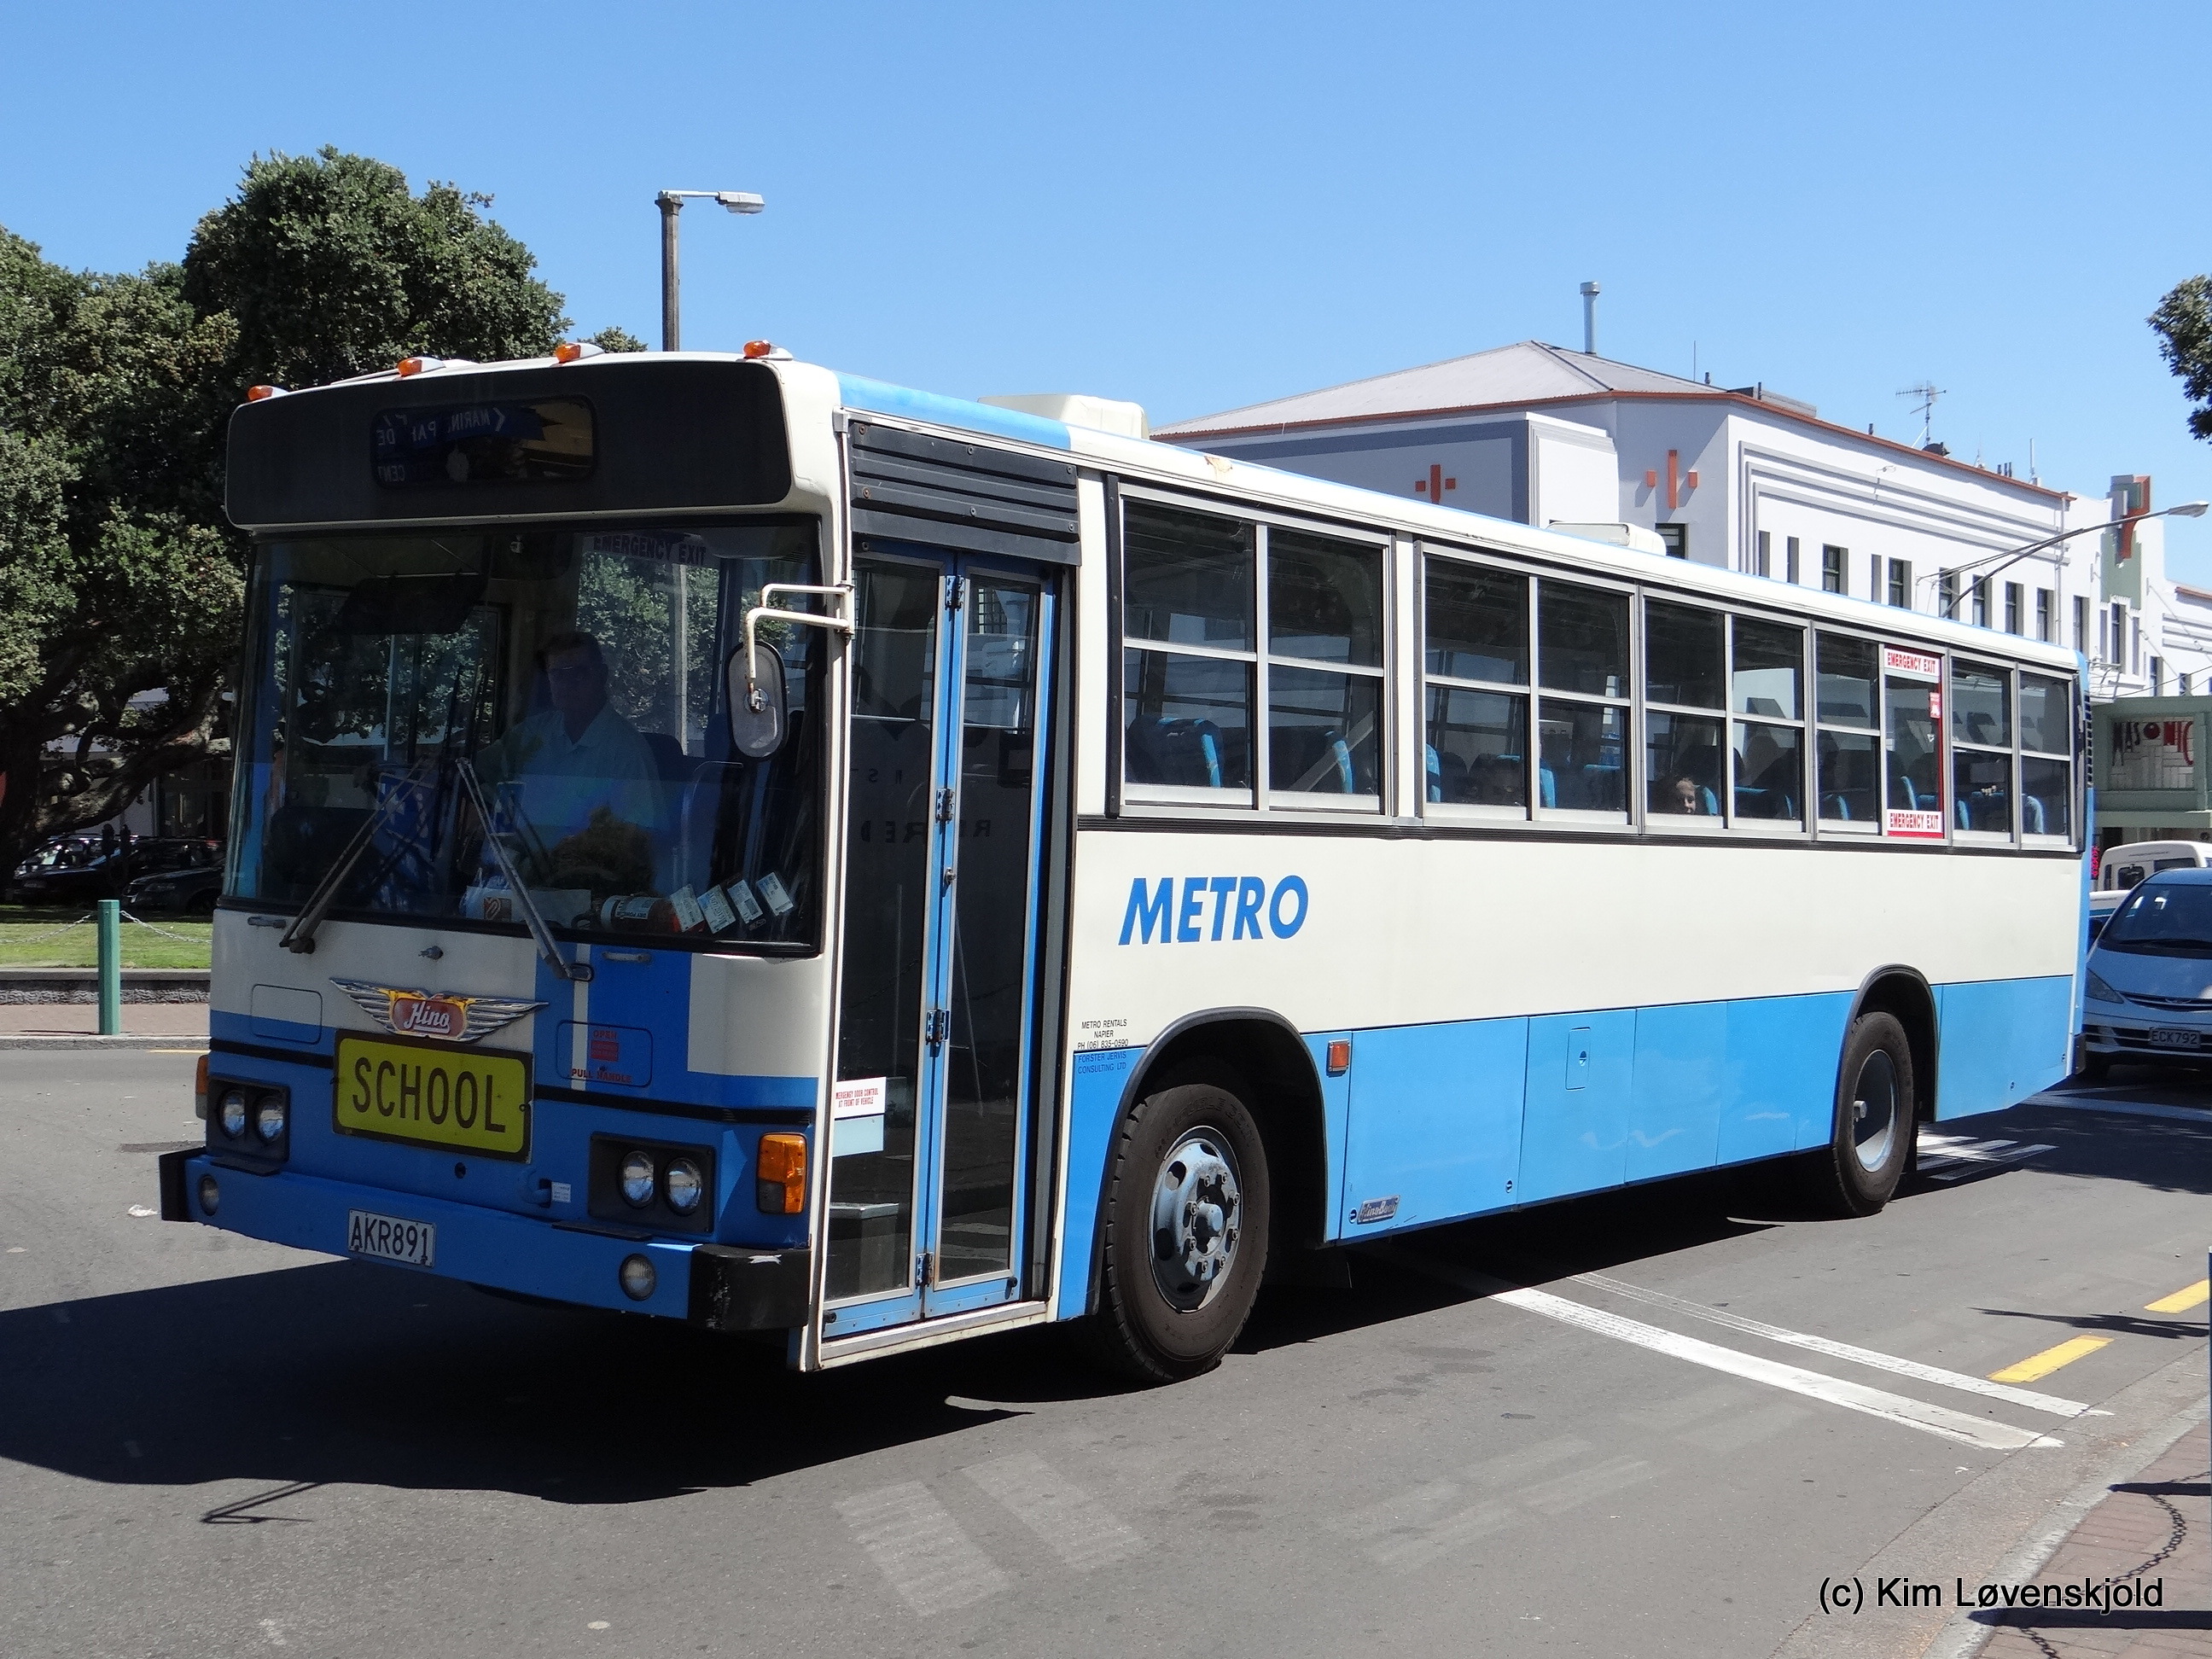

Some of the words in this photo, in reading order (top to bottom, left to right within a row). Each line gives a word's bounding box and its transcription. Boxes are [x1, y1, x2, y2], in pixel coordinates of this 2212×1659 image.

[594, 535, 672, 561] EMERGENCY
[679, 544, 706, 565] EXIT
[1887, 652, 1921, 672] EMERGENCY
[1924, 660, 1936, 674] EXIT
[2112, 721, 2194, 766] MASONIC
[1889, 812, 1924, 829] EMERGENCY
[1926, 814, 1940, 830] EXIT
[1118, 875, 1309, 946] METRO
[404, 1001, 450, 1032] Hino
[1081, 1021, 1101, 1029] METRO
[1103, 1019, 1128, 1028] RENTALS
[1094, 1030, 1114, 1039] NAPIER
[2152, 1031, 2197, 1044] ECK792
[1077, 1041, 1085, 1050] PH
[1087, 1040, 1099, 1050] (06)
[1101, 1039, 1129, 1048] 835-0590
[1079, 1052, 1105, 1063] FORSTER
[1107, 1051, 1126, 1061] JERVIS
[572, 1068, 592, 1078] PULL
[597, 1071, 632, 1083] HANDLE
[1078, 1063, 1114, 1074] CONSULTING
[352, 1057, 505, 1133] SCHOOL
[835, 1091, 853, 1100] MERGENCY
[854, 1090, 863, 1098] DOOR
[864, 1088, 878, 1097] CONTROL
[844, 1098, 854, 1107] FRONT
[861, 1097, 874, 1105] VEHICLE
[351, 1215, 428, 1260] AKR891
